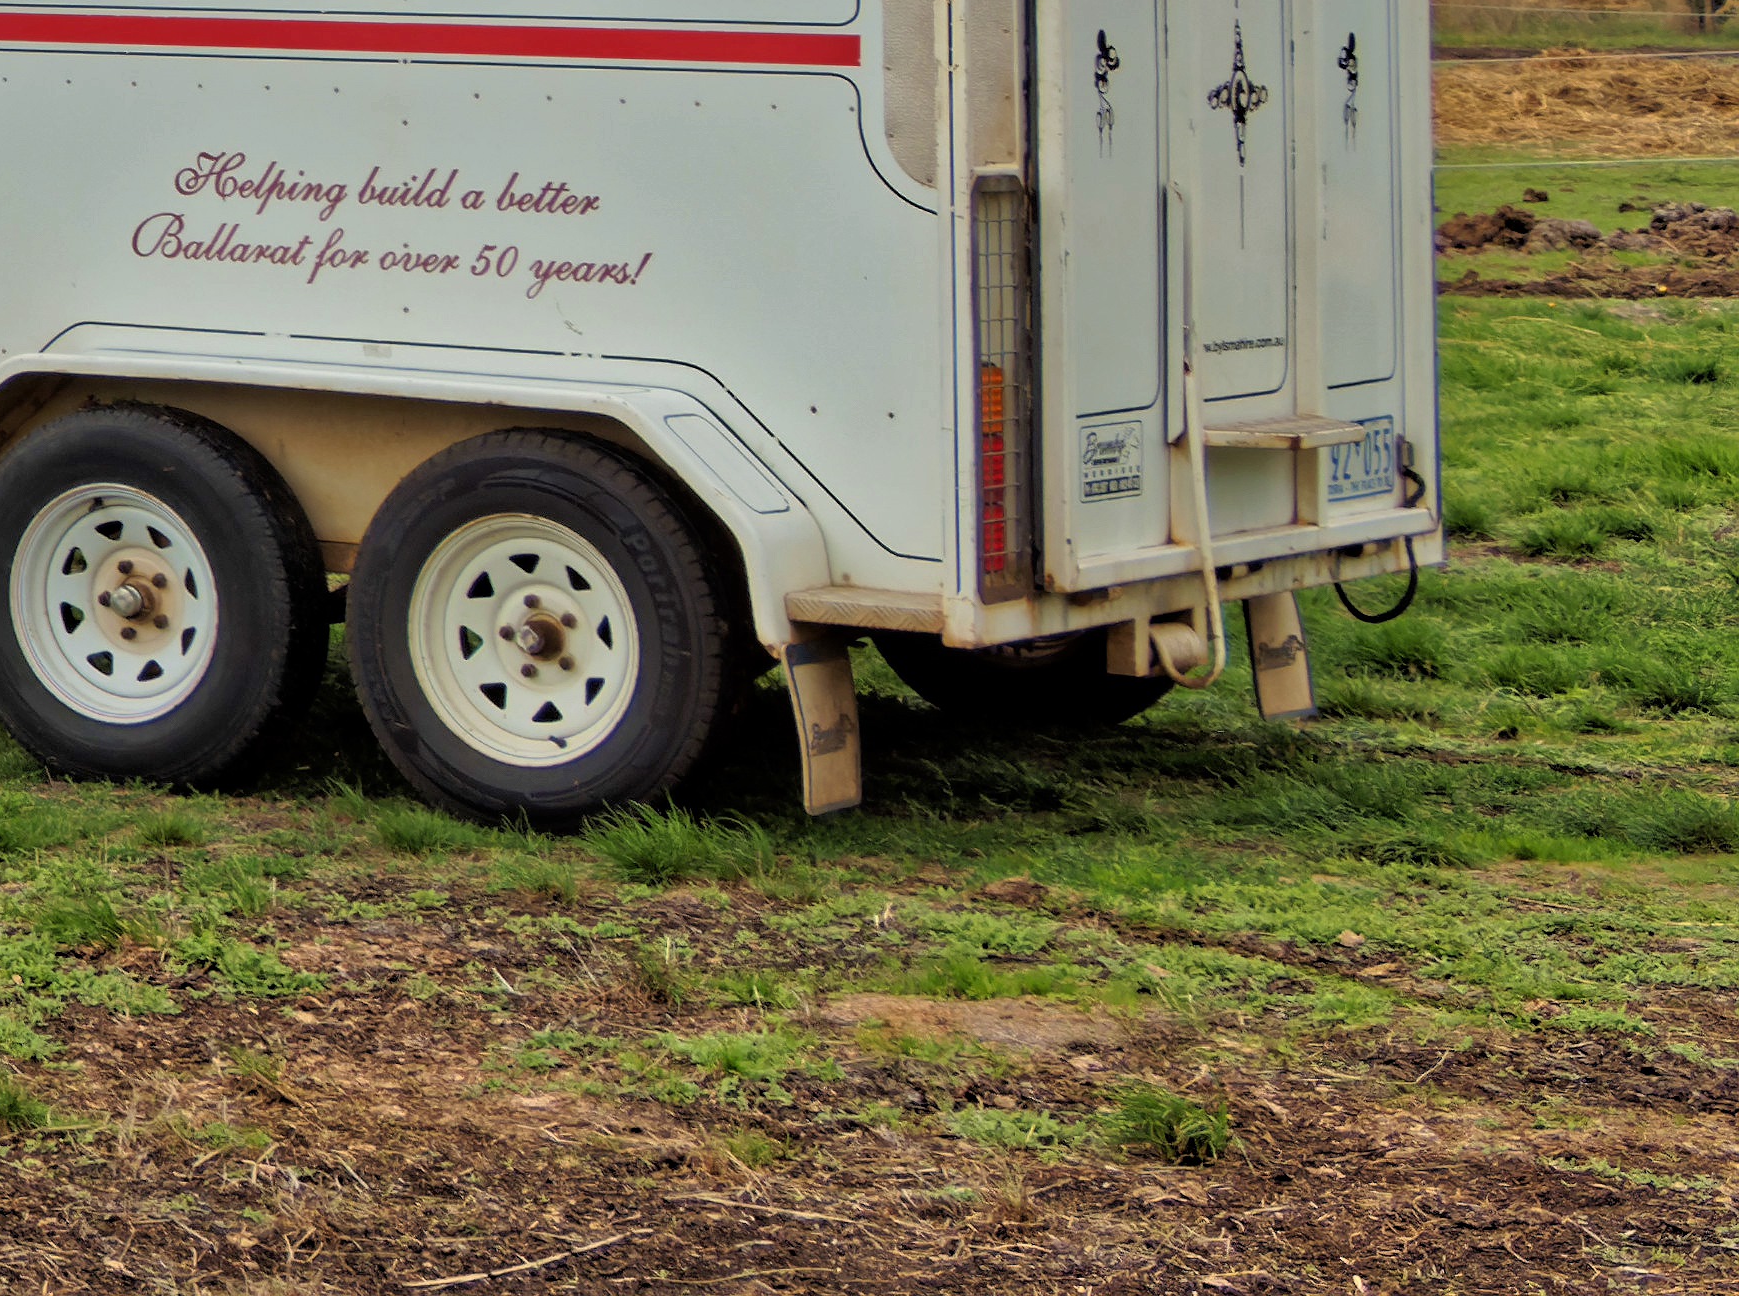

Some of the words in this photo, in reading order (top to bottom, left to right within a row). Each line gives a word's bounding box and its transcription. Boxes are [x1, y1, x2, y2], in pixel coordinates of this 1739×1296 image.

[175, 151, 347, 221] Helping
[357, 166, 458, 210] build
[460, 190, 486, 210] a
[496, 172, 601, 216] better
[131, 212, 312, 266] Ballarat
[307, 227, 370, 285] for
[379, 250, 460, 276] over
[470, 244, 518, 279] 50
[526, 252, 653, 299] years!
